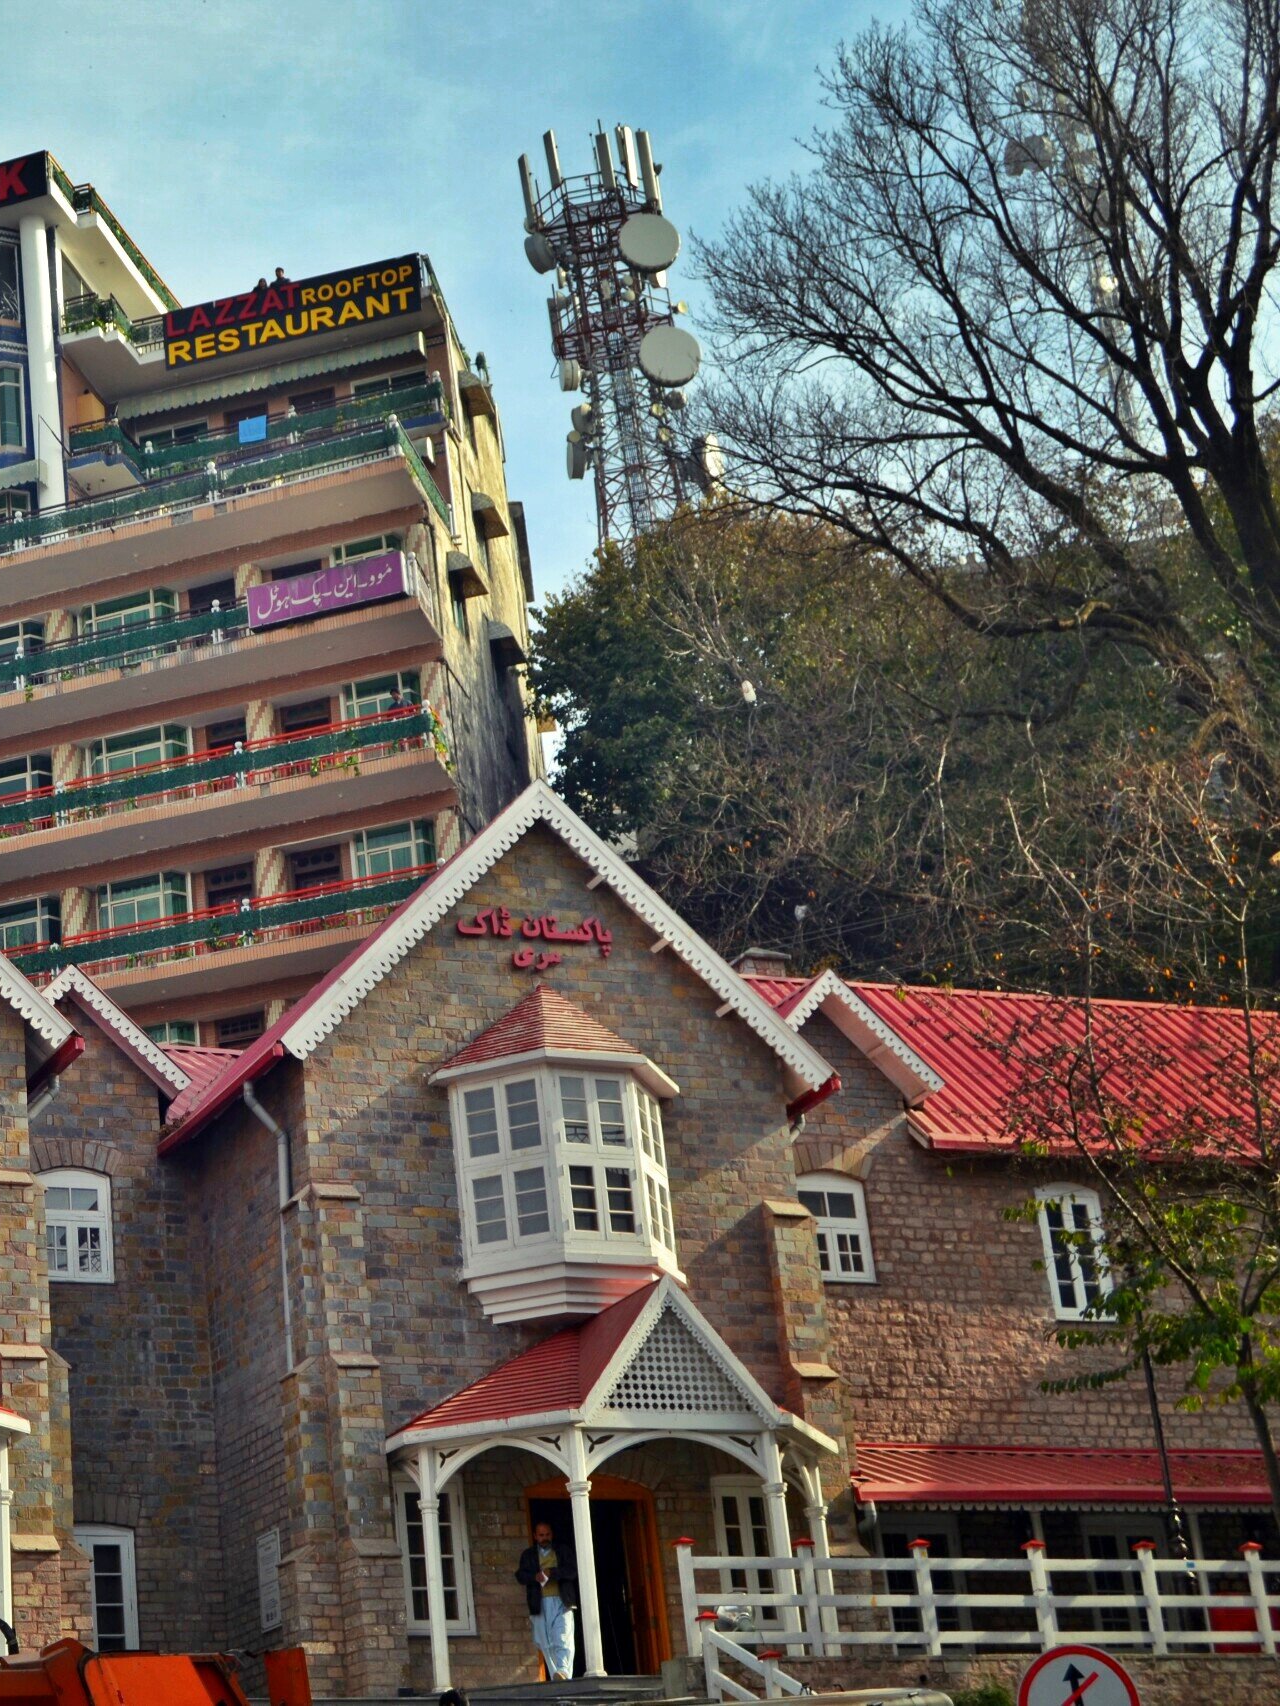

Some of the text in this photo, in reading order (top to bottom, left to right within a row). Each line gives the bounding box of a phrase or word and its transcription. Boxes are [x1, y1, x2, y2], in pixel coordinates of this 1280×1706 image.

[166, 282, 300, 338] LAZZAT
[167, 286, 414, 366] RESTAURANT
[256, 585, 290, 620] ہوٹل
[456, 904, 613, 958] پاکستان ڈاک
[511, 946, 562, 971] مری
